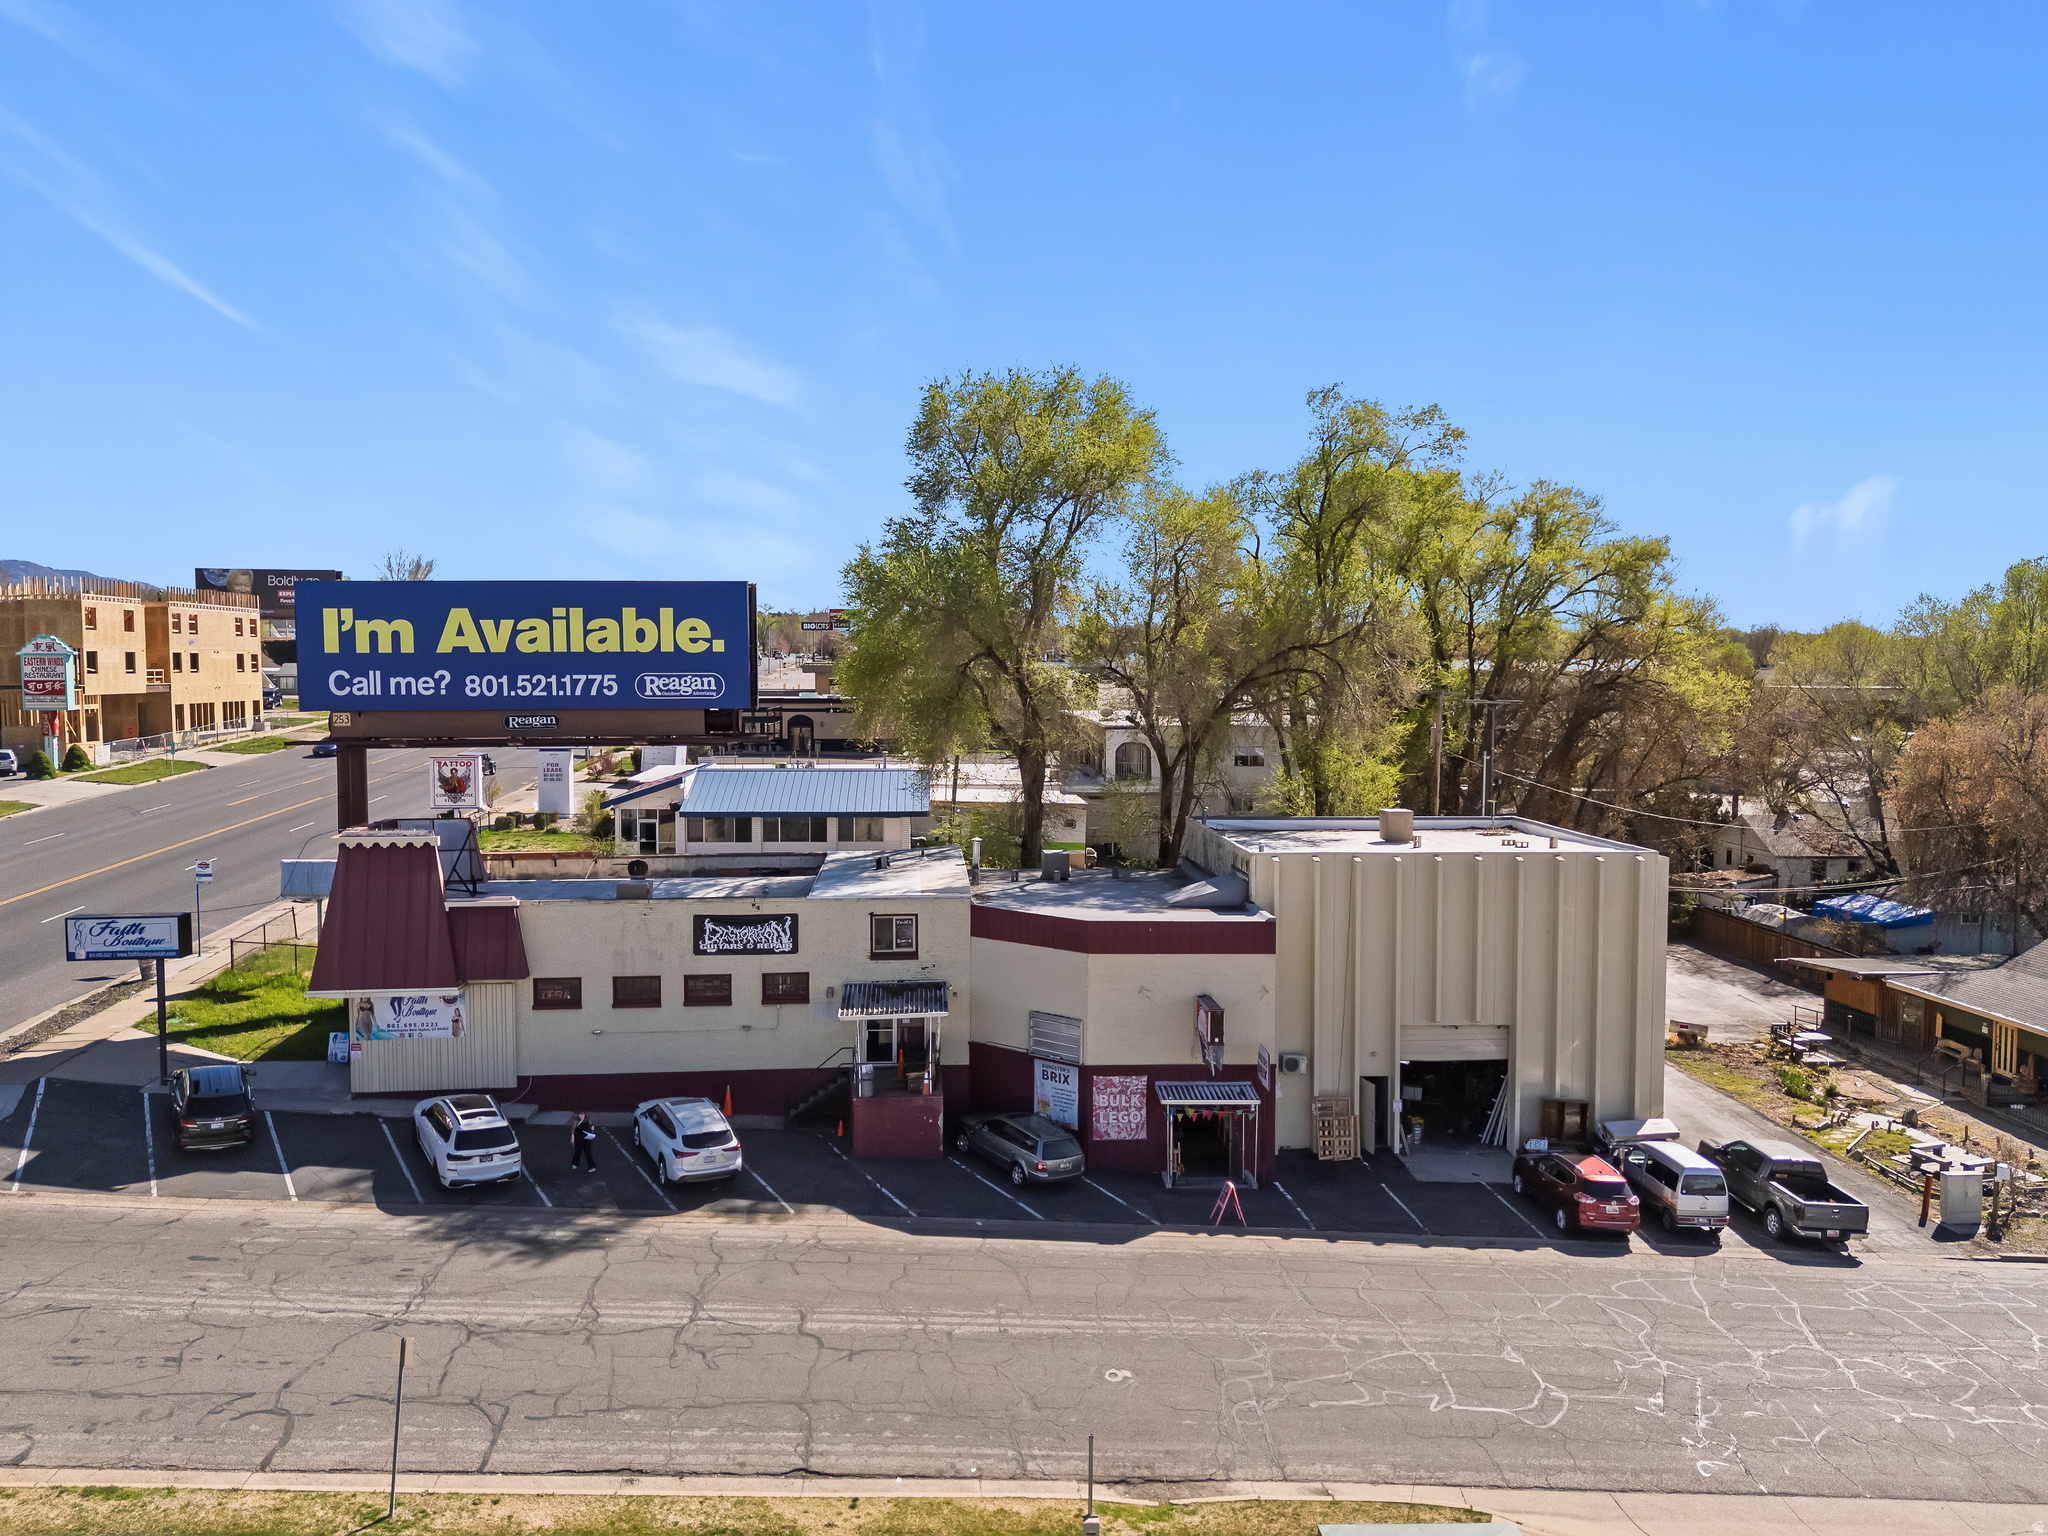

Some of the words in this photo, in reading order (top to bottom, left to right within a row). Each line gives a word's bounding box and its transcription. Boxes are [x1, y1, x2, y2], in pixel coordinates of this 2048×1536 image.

[322, 607, 415, 654] I'm
[435, 607, 725, 654] Available.
[24, 657, 47, 666] EASTERN
[47, 657, 64, 666] WINDS
[328, 669, 382, 696] Call
[389, 669, 451, 696] me?
[464, 674, 618, 697] 801.521.1775
[643, 675, 717, 696] Reagan
[333, 714, 350, 724] 253
[508, 715, 557, 729] Reagan
[436, 760, 473, 768] TATTOO
[89, 919, 147, 938] Faith
[103, 935, 166, 947] Boutique
[700, 942, 744, 950] GUITARS
[756, 942, 793, 950] REPAIR
[402, 1004, 437, 1018] Boutique
[1041, 1069, 1071, 1086] BRIX
[1099, 1094, 1141, 1107] BULK
[1100, 1110, 1141, 1124] LEGO
